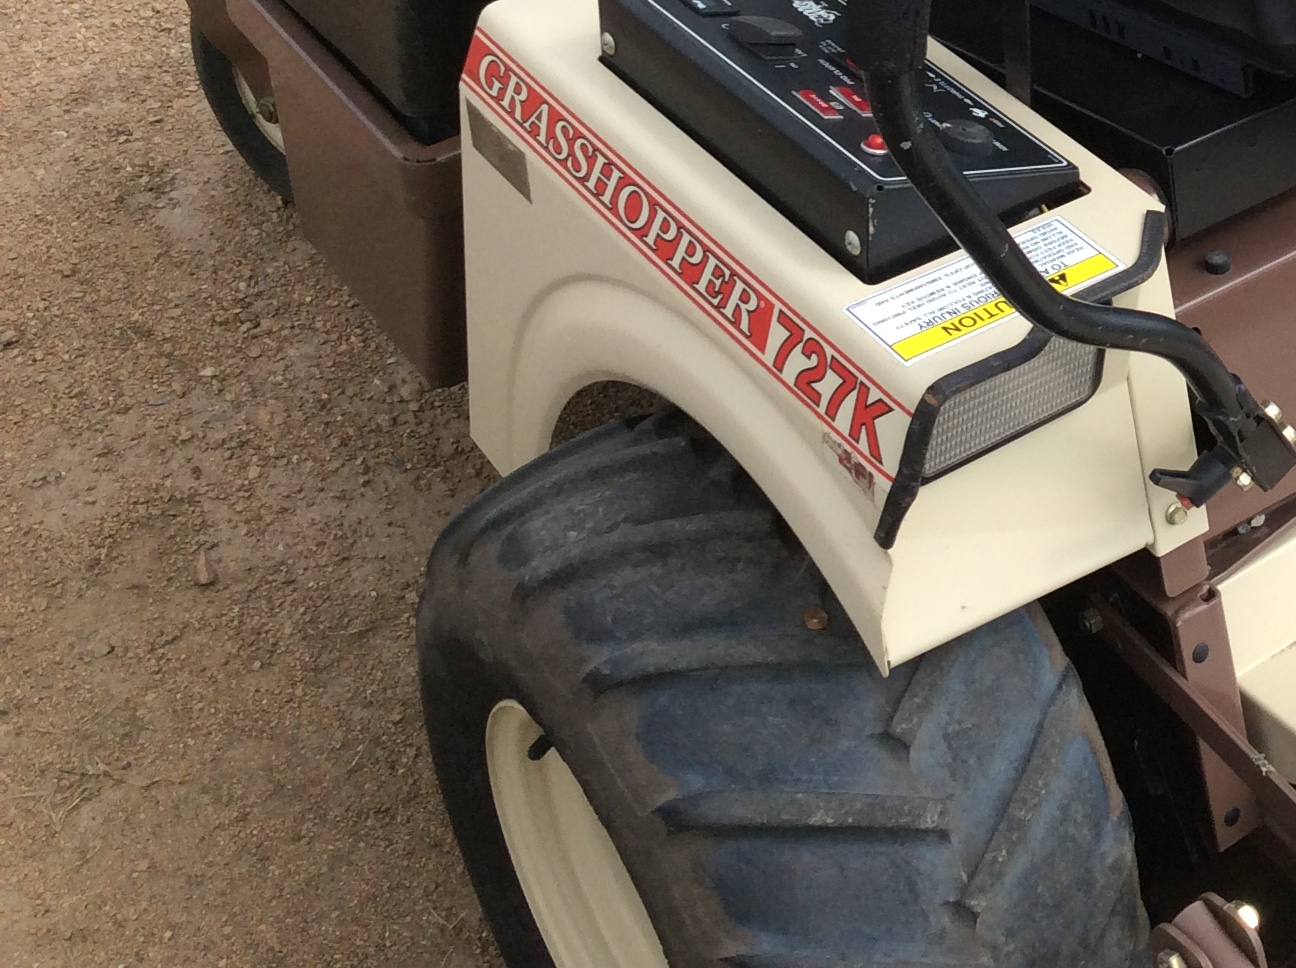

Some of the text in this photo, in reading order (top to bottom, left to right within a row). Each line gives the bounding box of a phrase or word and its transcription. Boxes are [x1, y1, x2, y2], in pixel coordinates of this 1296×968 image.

[477, 52, 896, 466] GRASSHOPPER 727K
[1050, 261, 1068, 270] TO
[917, 307, 961, 330] INJURY
[940, 300, 1014, 336] UTION
